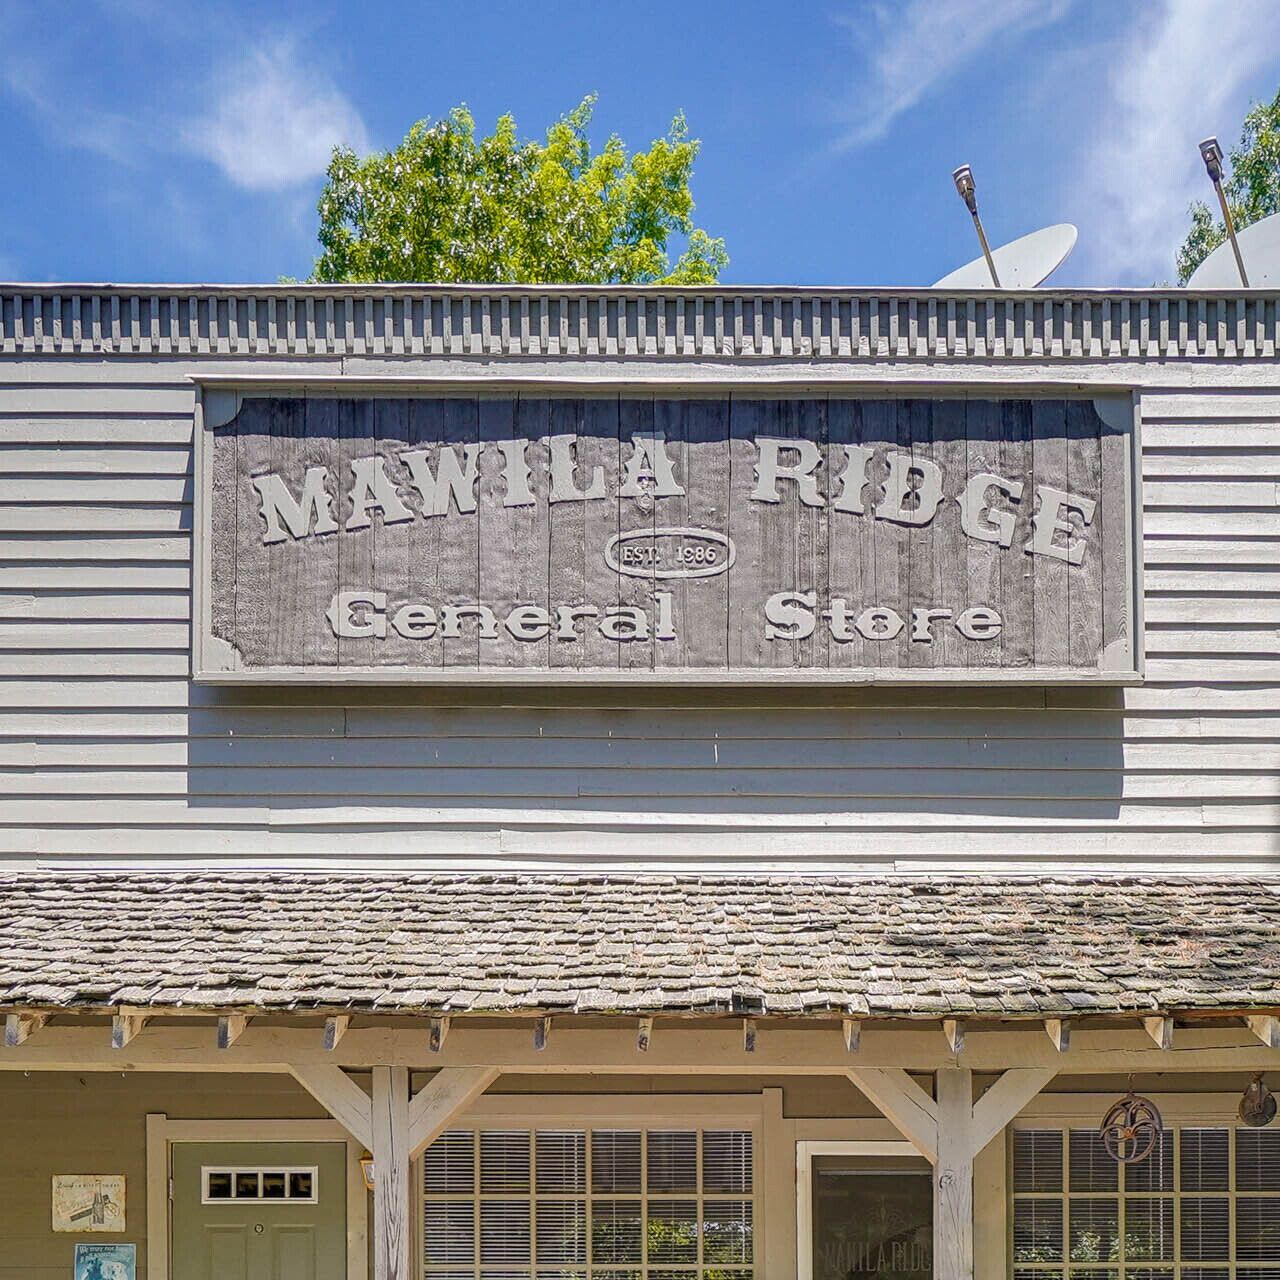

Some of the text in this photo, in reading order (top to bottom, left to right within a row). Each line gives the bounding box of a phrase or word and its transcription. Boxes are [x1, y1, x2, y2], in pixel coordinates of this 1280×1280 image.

[251, 432, 1097, 565] MAWILA RIDGE
[622, 546, 717, 564] EST. 1986
[325, 591, 1003, 643] General Store
[891, 1240, 932, 1272] RIDG
